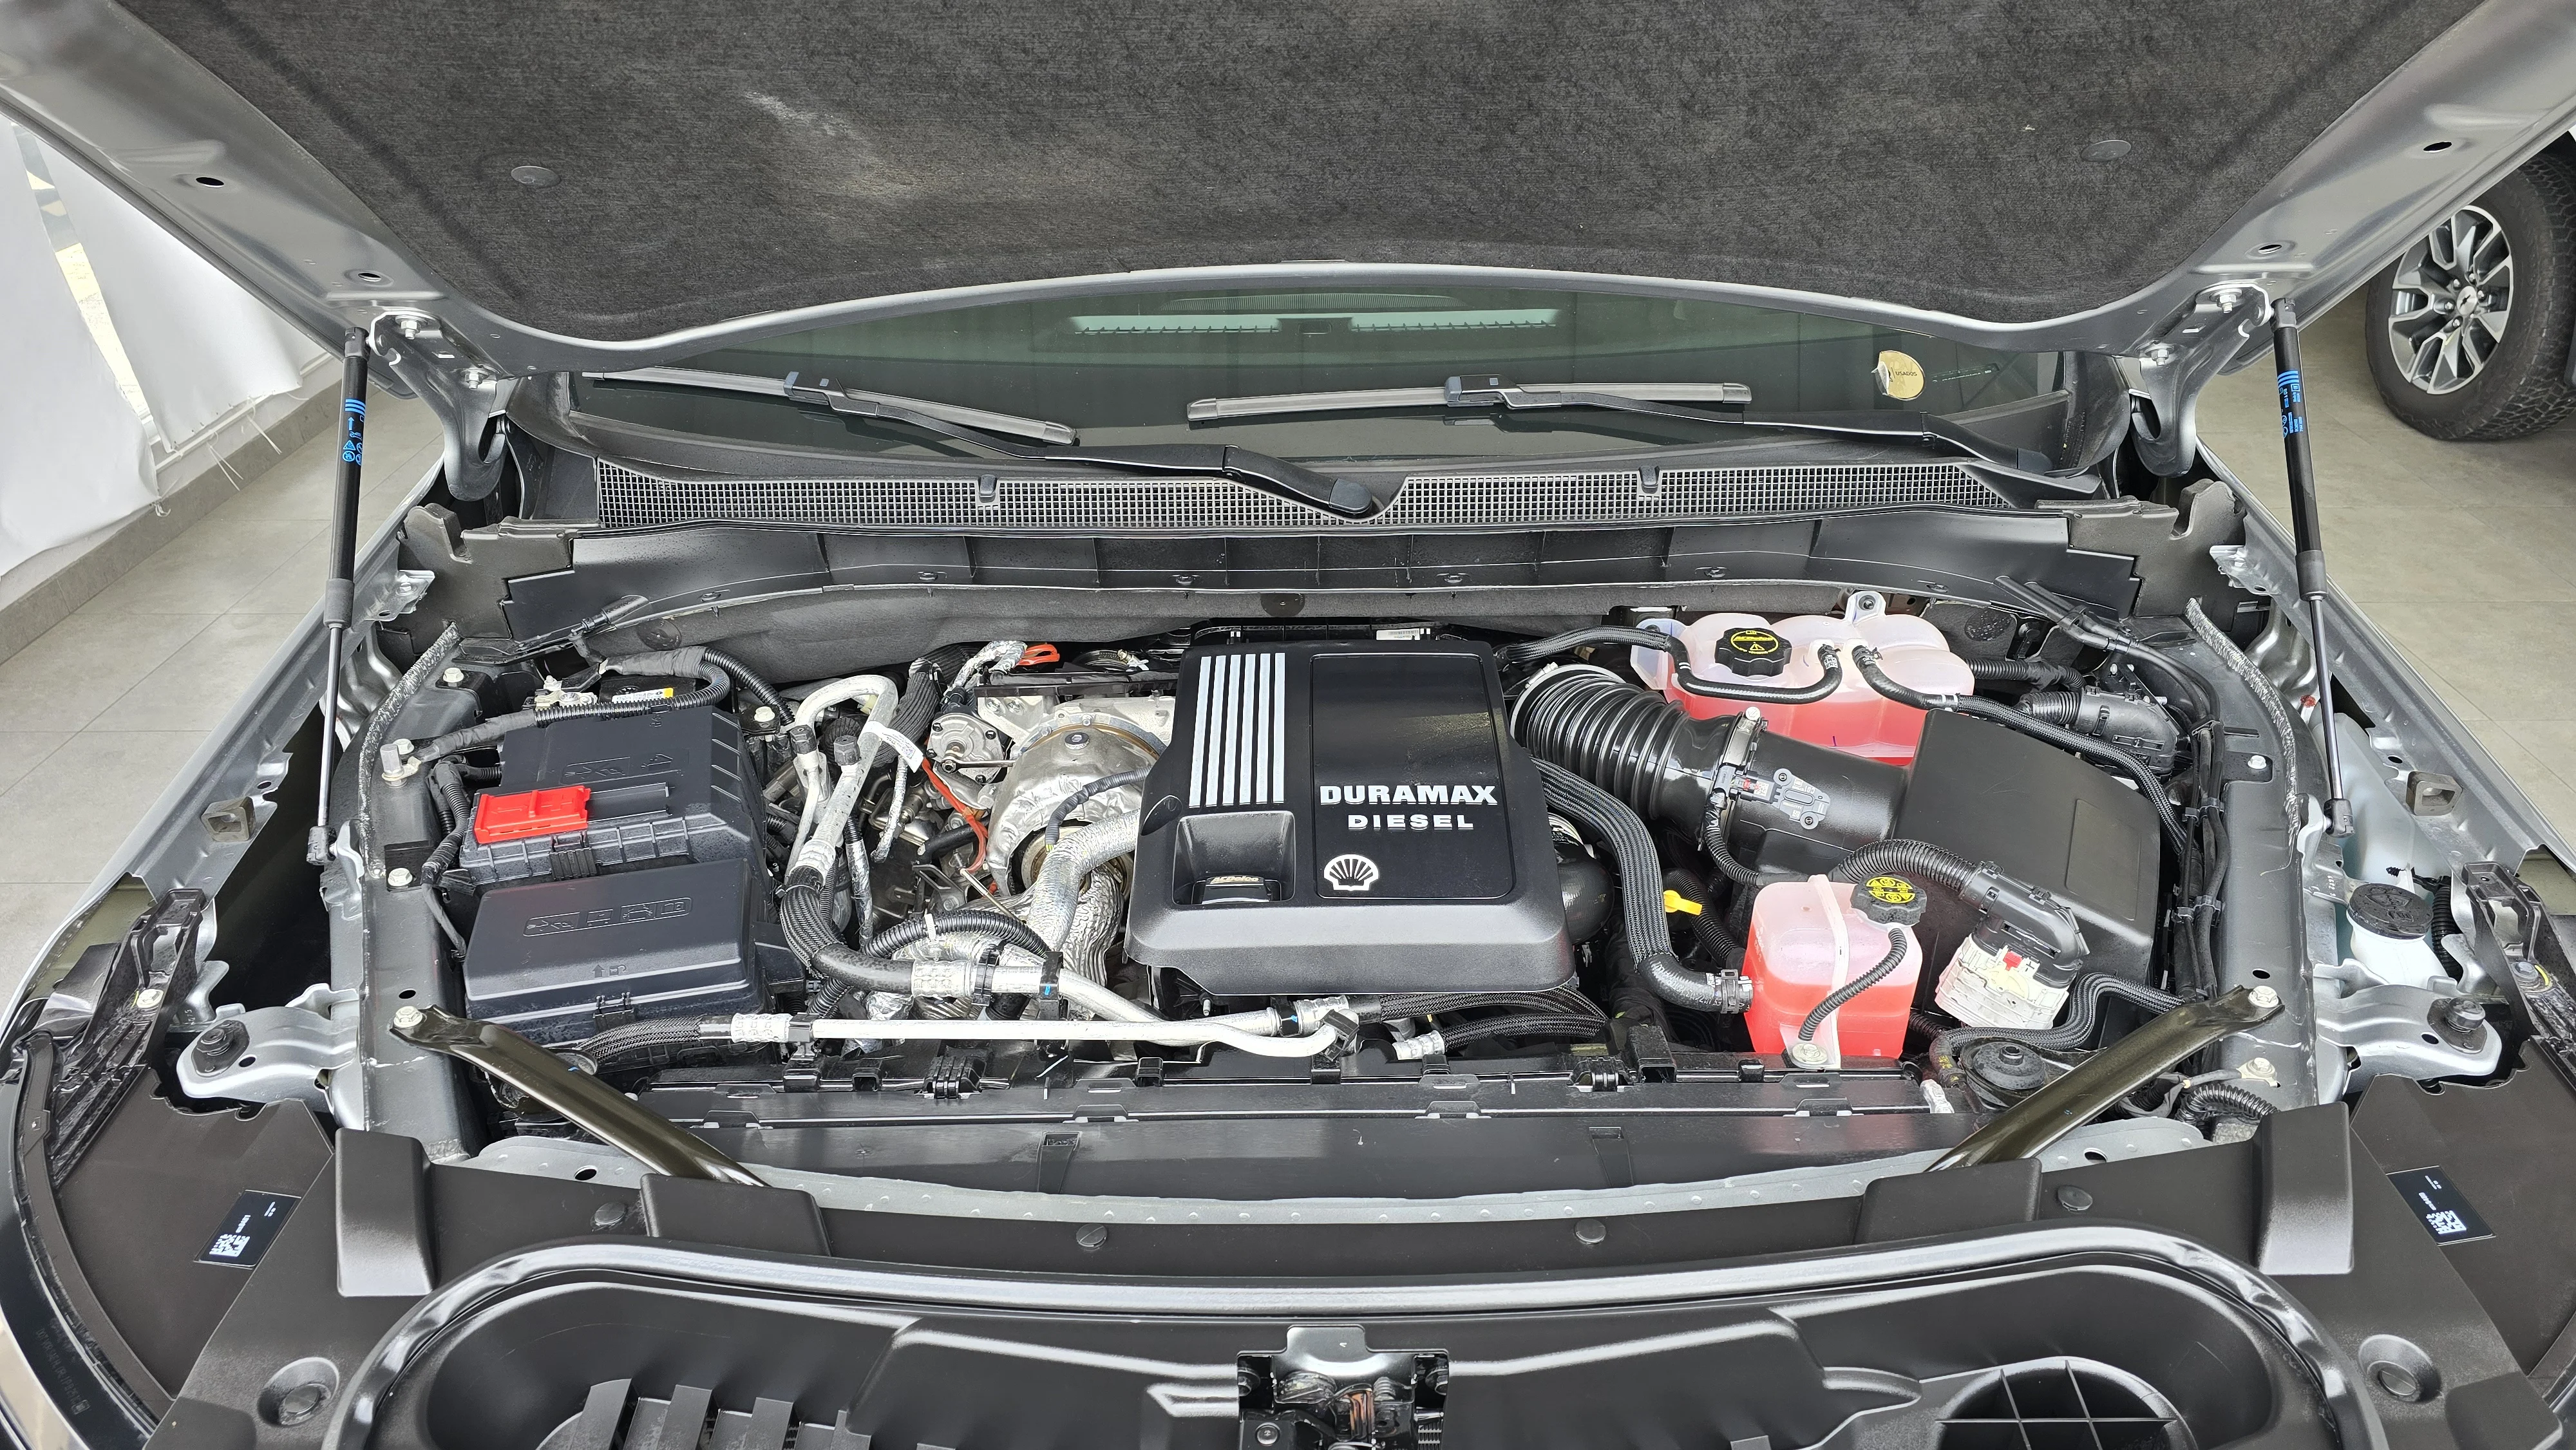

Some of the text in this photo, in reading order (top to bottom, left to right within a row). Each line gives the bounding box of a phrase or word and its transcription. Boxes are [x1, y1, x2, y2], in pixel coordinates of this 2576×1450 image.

[1320, 785, 1497, 805] DURAMAX
[1347, 813, 1474, 831] DIESEL
[1209, 876, 1260, 884] ACDelco
